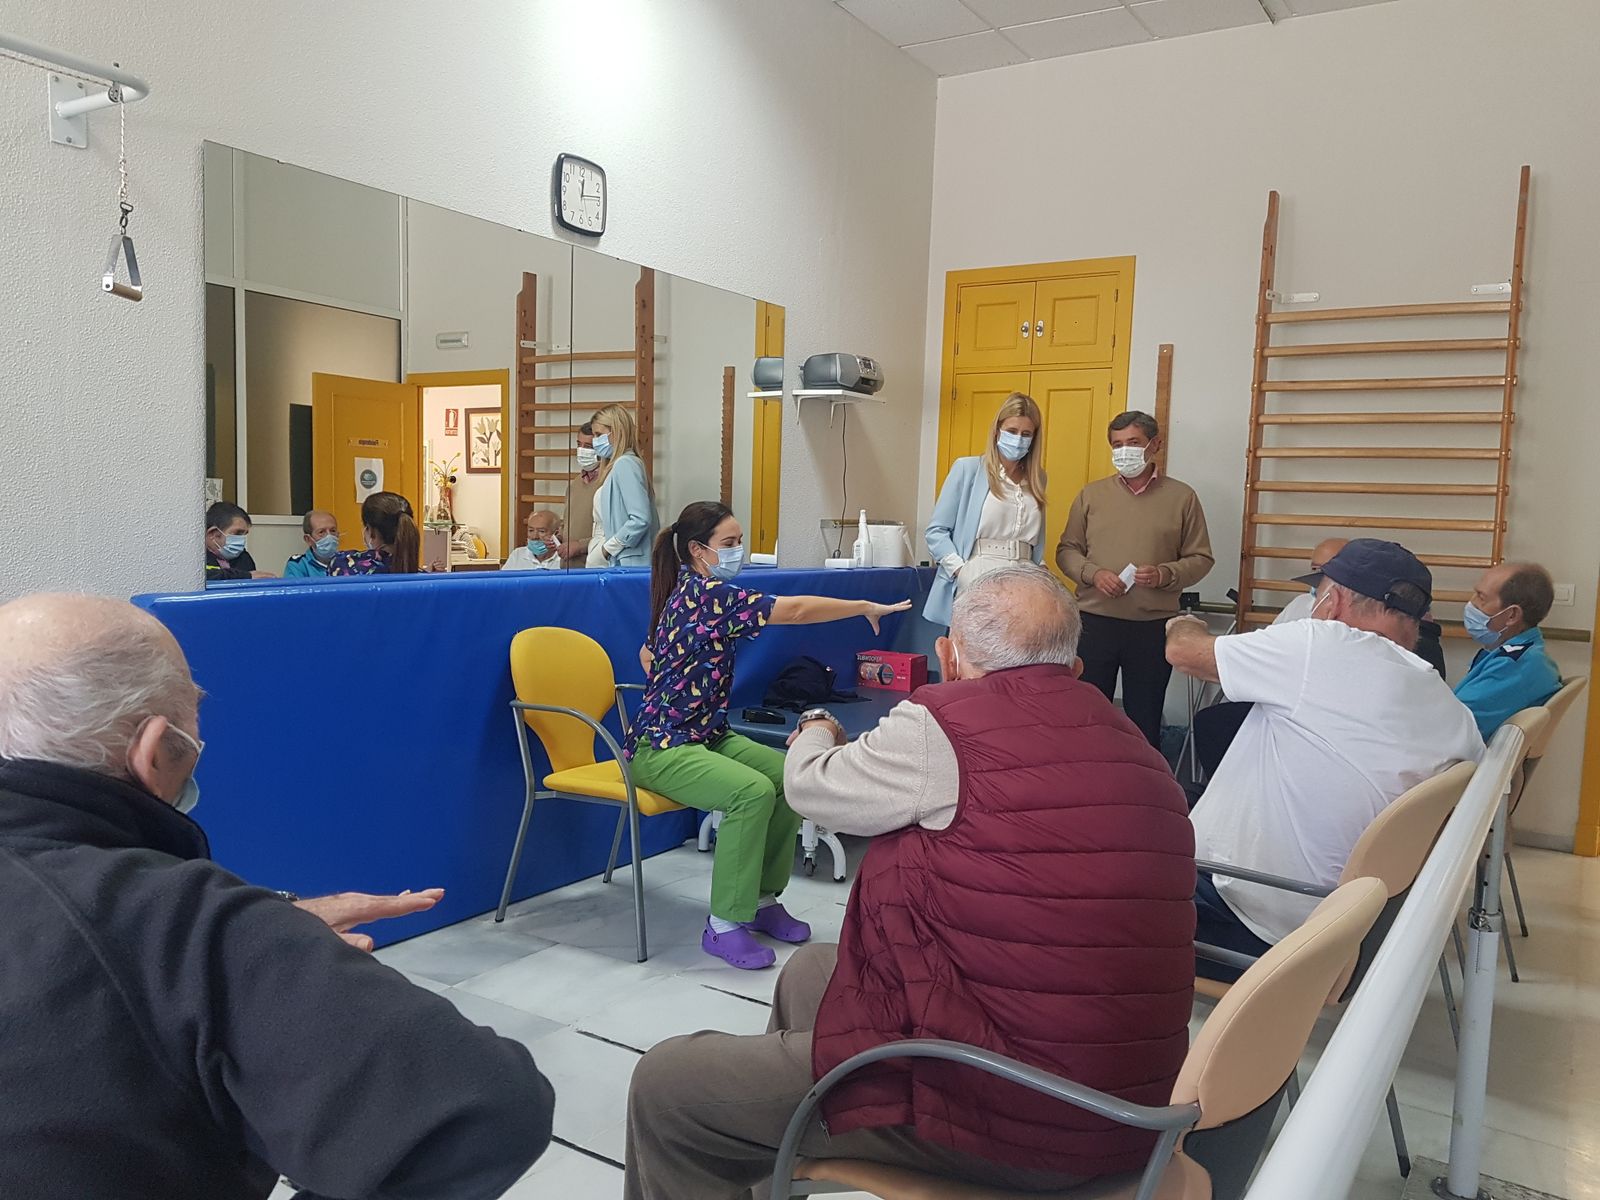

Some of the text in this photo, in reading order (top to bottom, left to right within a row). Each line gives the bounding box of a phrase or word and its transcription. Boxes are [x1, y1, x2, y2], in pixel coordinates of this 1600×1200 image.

[563, 171, 570, 183] 10
[579, 166, 585, 178] 12
[562, 185, 567, 196] 9
[595, 182, 600, 193] 2
[563, 200, 567, 211] 8
[571, 211, 575, 221] 7
[579, 214, 583, 225] 6
[595, 211, 600, 220] 4
[588, 216, 592, 227] 5
